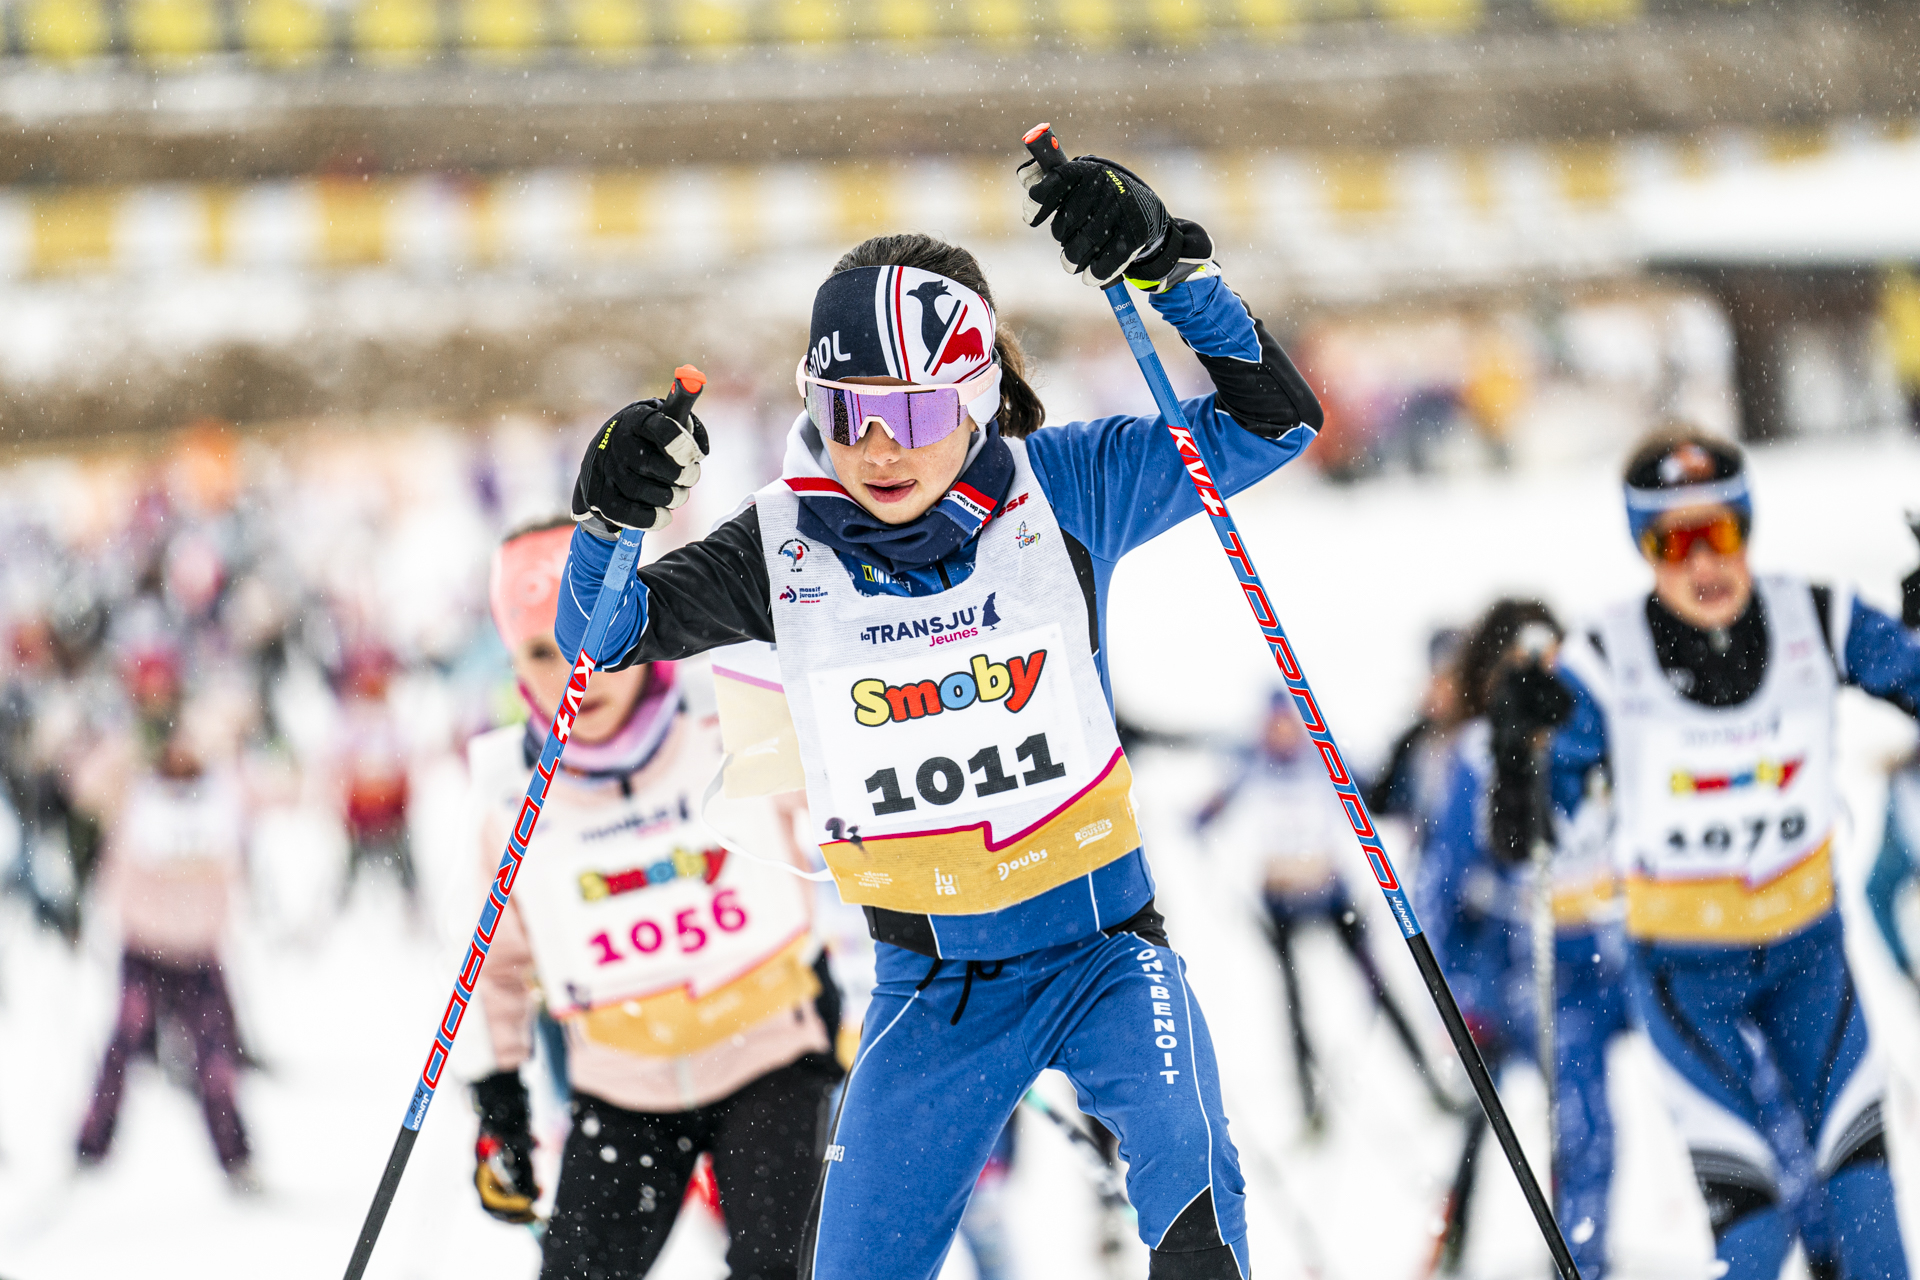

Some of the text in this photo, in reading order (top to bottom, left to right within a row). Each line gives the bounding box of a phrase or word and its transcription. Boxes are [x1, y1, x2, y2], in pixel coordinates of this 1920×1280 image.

[929, 627, 979, 647] Jeunes
[851, 649, 1047, 727] Smoby
[1224, 531, 1400, 891] TORNADO
[865, 732, 1067, 816] 1011
[422, 757, 560, 1091] TORNADO
[588, 888, 748, 967] 1056
[1392, 896, 1415, 935] JUNIOR
[1130, 946, 1180, 1085] ONTBENOIT
[412, 1093, 430, 1131] JUNIOR
